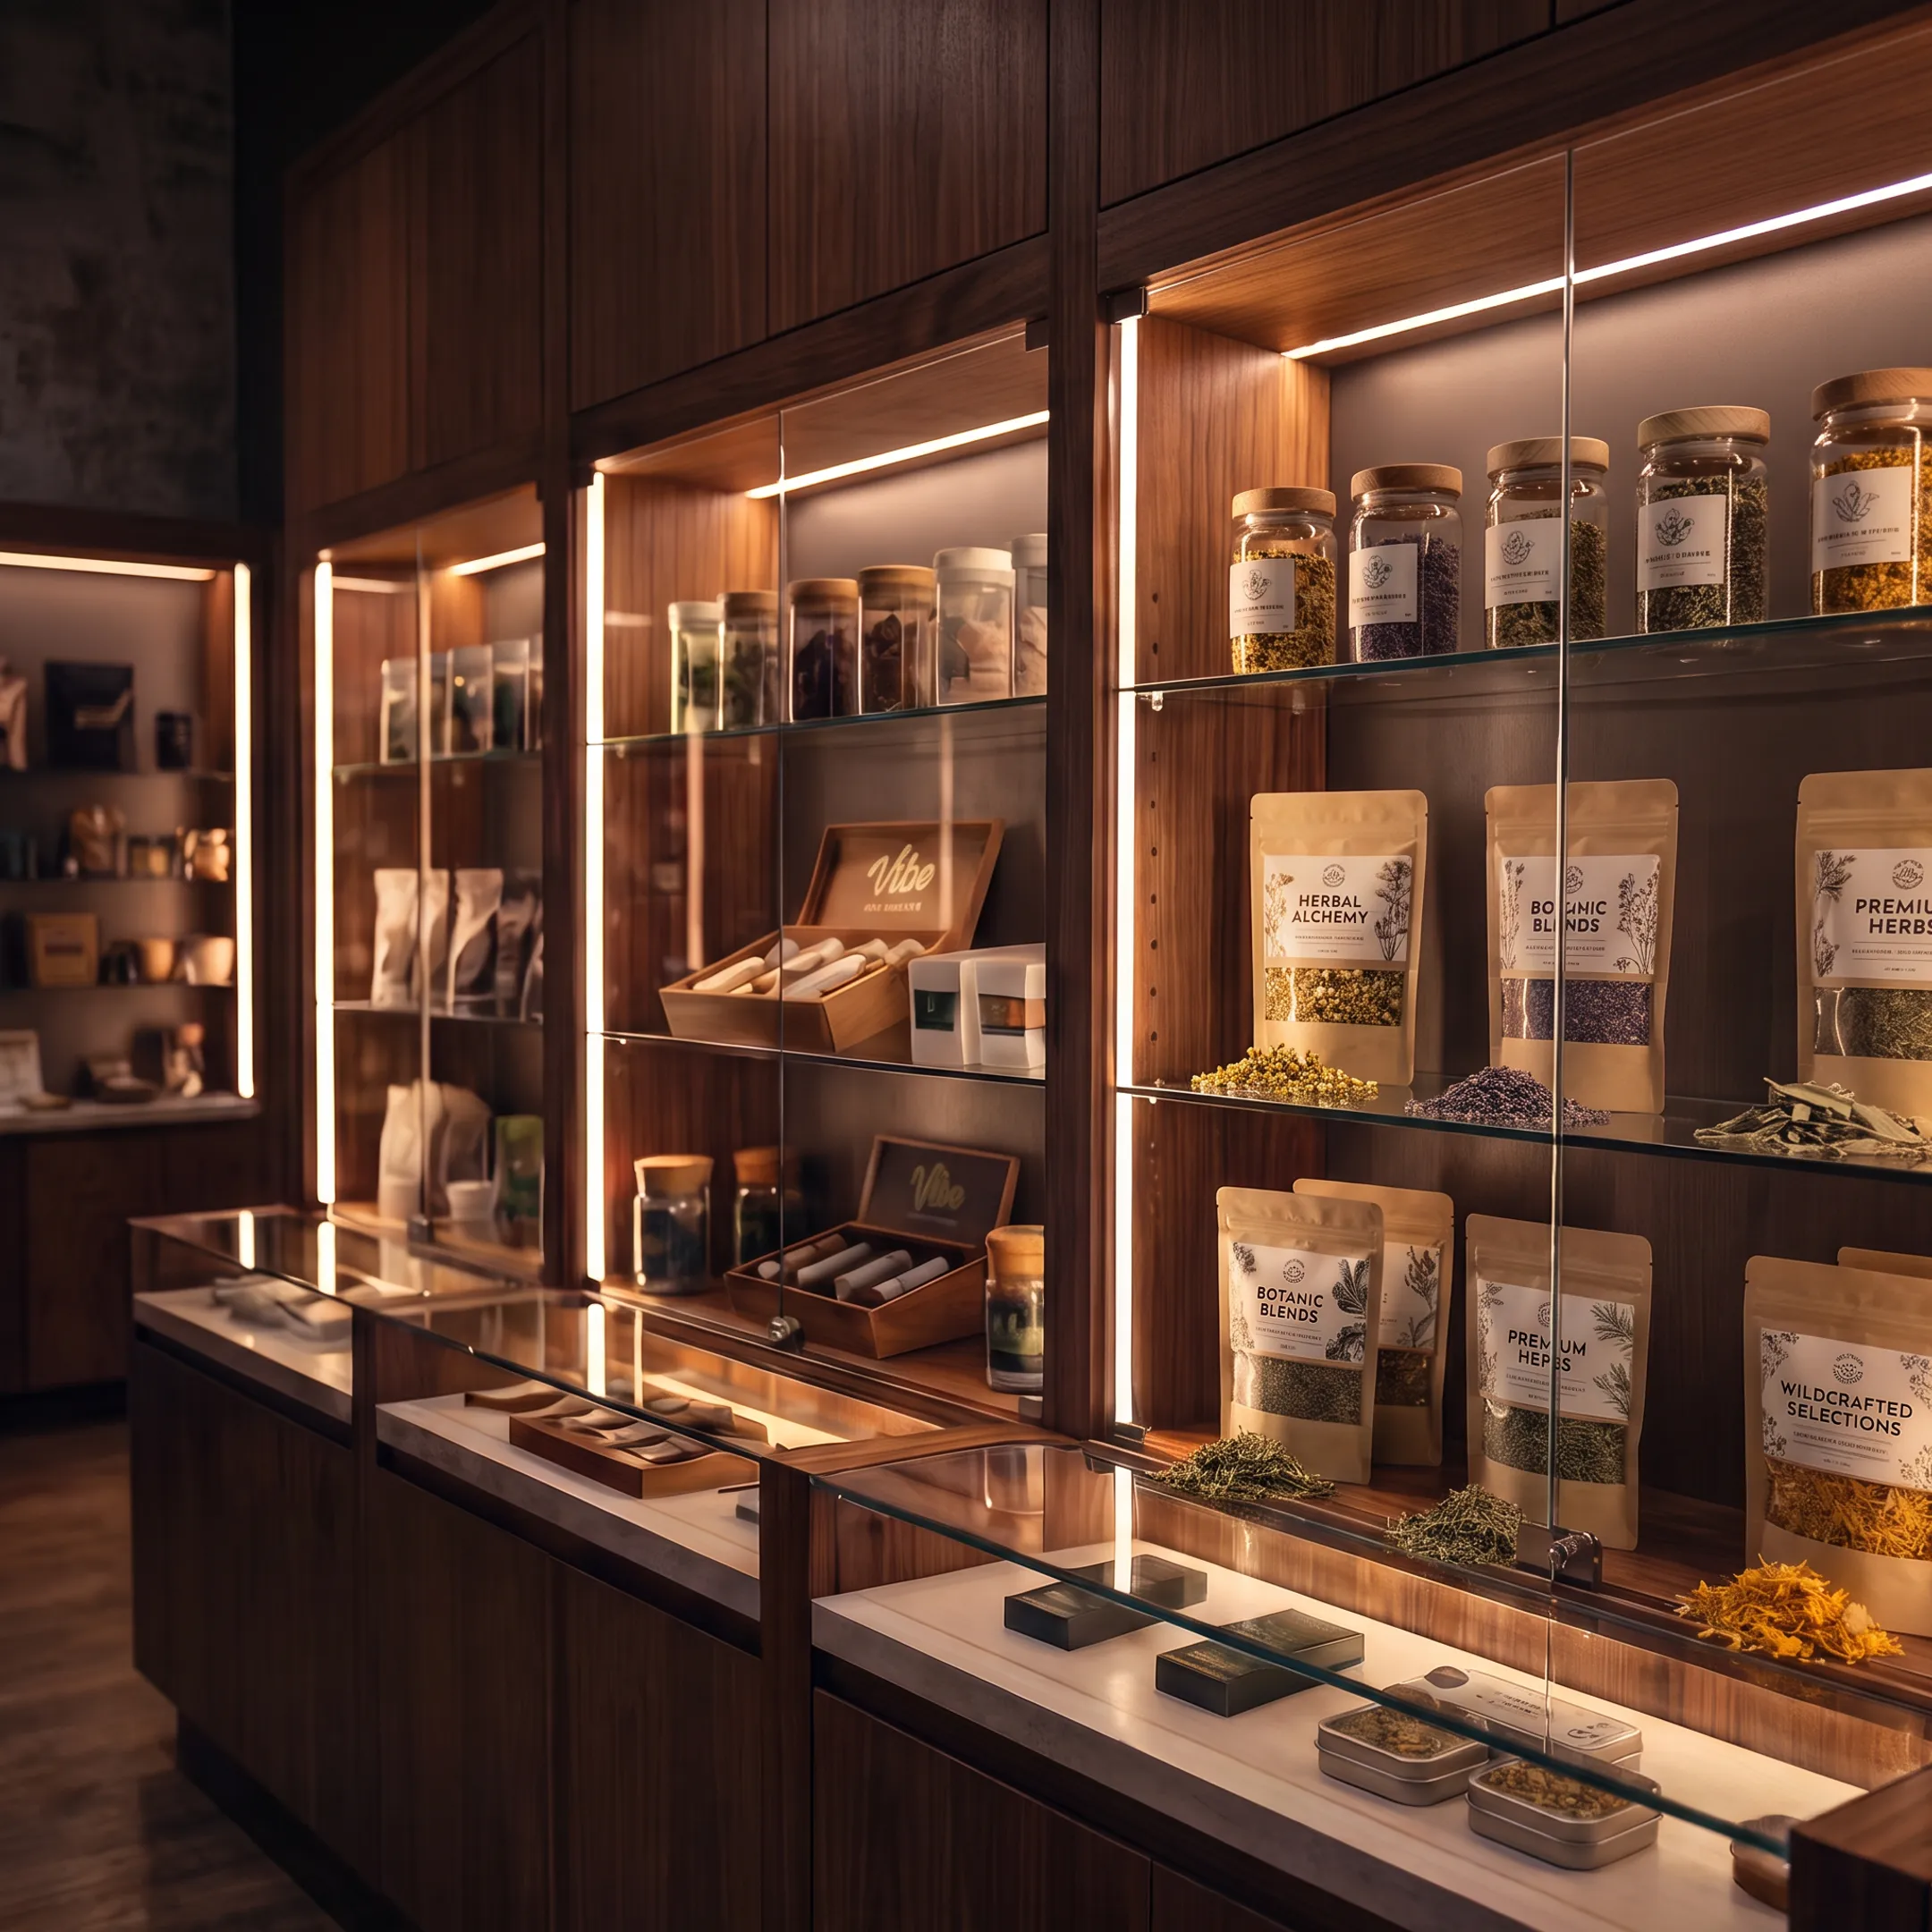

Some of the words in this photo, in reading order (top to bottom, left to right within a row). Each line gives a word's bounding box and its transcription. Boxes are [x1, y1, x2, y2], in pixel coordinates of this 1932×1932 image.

[868, 843, 936, 895] Vibe
[1299, 894, 1361, 908] HERBAL
[1531, 901, 1607, 915] BOANIC
[1292, 910, 1368, 924] ALCHEMY
[1533, 918, 1599, 932] BLNDS
[1257, 1286, 1324, 1308] BOTANIC
[1259, 1302, 1318, 1324] BLENDS
[1508, 1329, 1586, 1356] PREMUM
[1781, 1379, 1913, 1419] WILDCRAFTED
[1787, 1401, 1902, 1436] SELECTIONS
